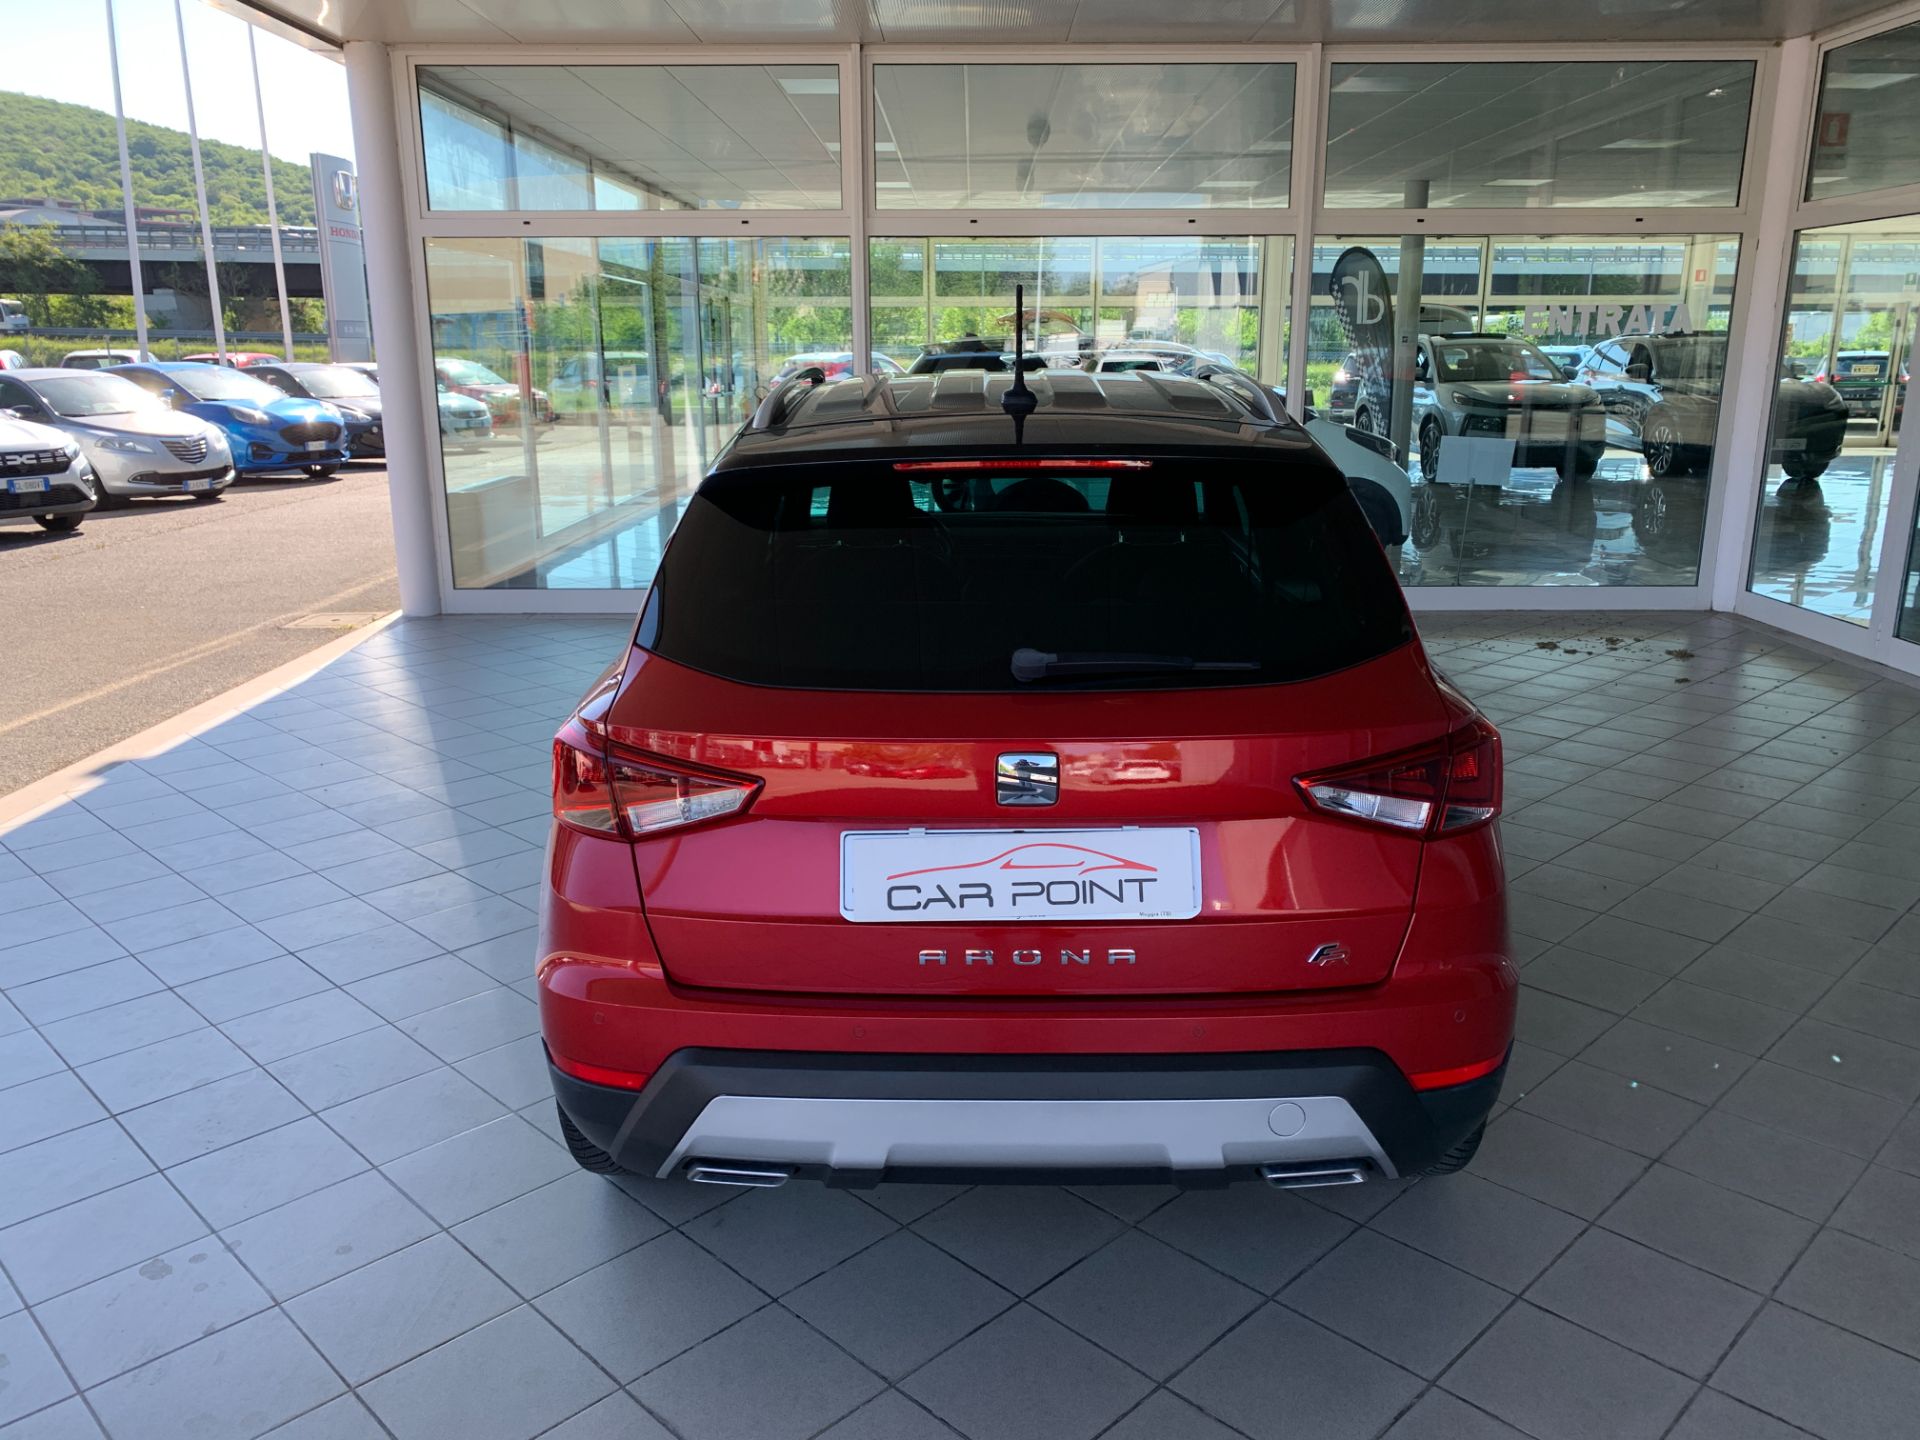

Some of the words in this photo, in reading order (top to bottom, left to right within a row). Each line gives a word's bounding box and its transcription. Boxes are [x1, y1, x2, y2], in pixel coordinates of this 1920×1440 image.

[1523, 304, 1694, 336] ENTRATA
[886, 882, 994, 911] CAR
[1011, 878, 1158, 907] POINT
[918, 949, 1136, 966] ARONA
